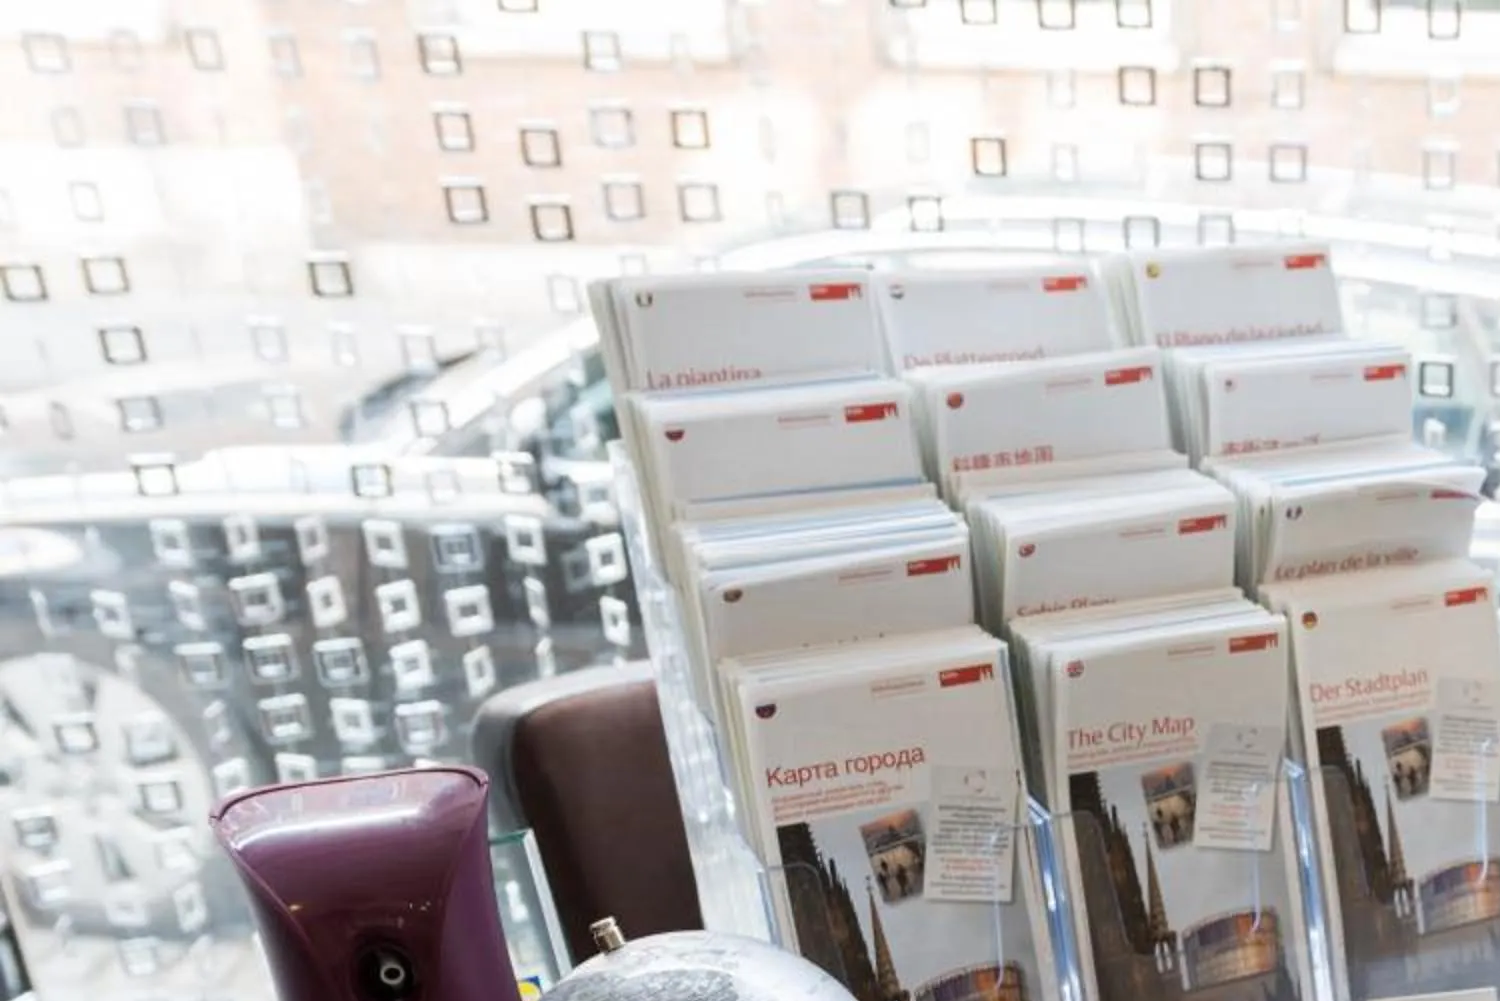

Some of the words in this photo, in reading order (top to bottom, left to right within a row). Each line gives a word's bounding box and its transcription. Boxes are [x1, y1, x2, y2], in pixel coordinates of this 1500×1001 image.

[646, 367, 671, 390] La
[1309, 682, 1340, 702] Der
[1344, 668, 1428, 699] Stadtplan
[1067, 727, 1103, 749] The
[1107, 720, 1147, 749] City
[1151, 716, 1195, 737] Map
[765, 760, 839, 788] Карта
[845, 746, 926, 776] города
